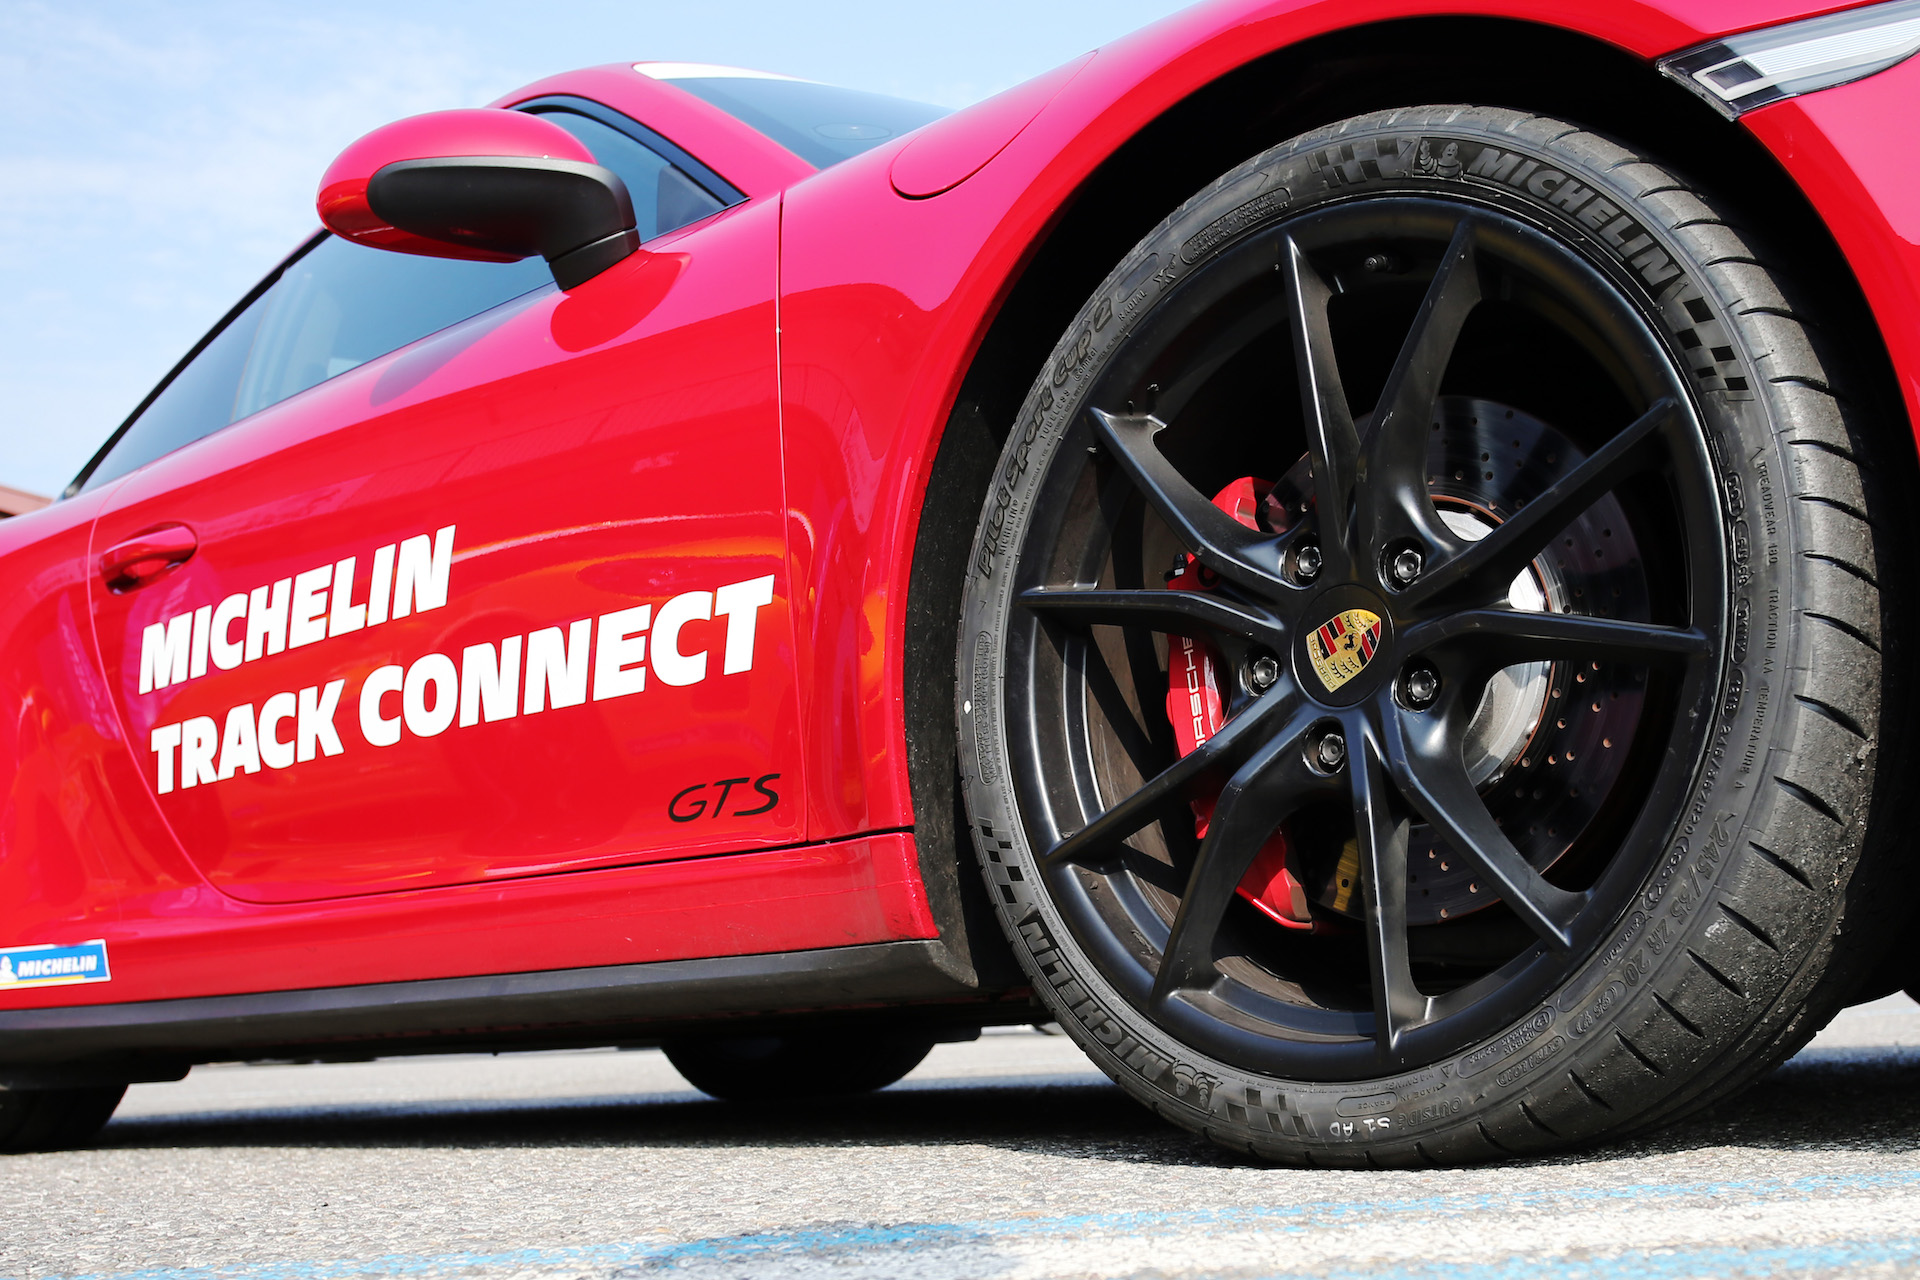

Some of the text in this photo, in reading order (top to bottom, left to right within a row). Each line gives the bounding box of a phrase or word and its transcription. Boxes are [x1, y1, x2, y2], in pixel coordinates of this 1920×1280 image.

[1467, 147, 1682, 292] MICHELIN
[1115, 287, 1148, 324] RADIAL
[976, 484, 1011, 580] Pilot
[1001, 384, 1058, 495] Sport
[1052, 329, 1094, 387] Cup
[1093, 298, 1115, 334] 2
[1038, 388, 1071, 442] TUBELESS
[1756, 460, 1777, 536] TREADWEAR
[138, 524, 456, 695] MICHELIN
[1762, 585, 1780, 675] TRACTION AA
[150, 573, 776, 796] TRACK CONNECT
[1733, 683, 1771, 792] TEMPERATURE A
[667, 772, 781, 824] GTS
[17, 954, 97, 978] MICHELIN
[1622, 948, 1653, 988] 20
[1645, 918, 1676, 957] ZR
[1018, 917, 1171, 1086] MICHELIN
[1357, 1084, 1439, 1110] MADE IN FRANCE
[1399, 1093, 1465, 1131] OUTSIDE
